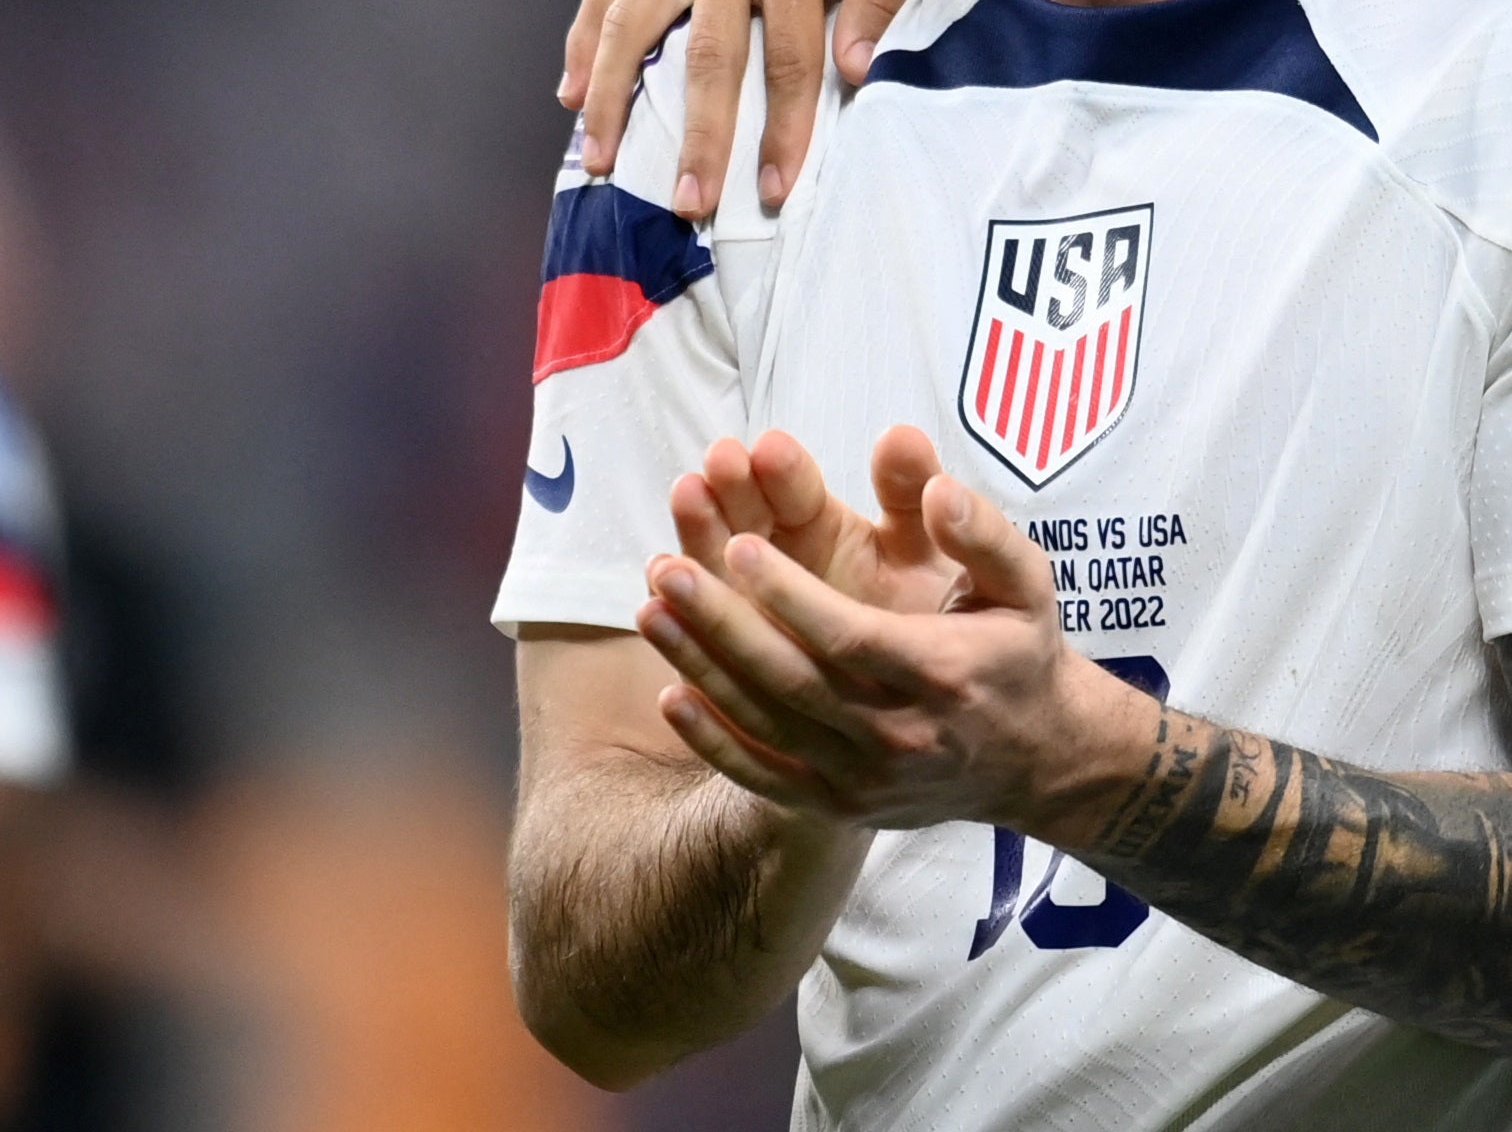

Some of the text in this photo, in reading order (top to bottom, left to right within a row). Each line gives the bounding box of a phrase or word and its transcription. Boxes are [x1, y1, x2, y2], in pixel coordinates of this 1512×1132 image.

[997, 224, 1141, 331] USA
[1027, 514, 1187, 552] ANDS VS USA
[1088, 555, 1167, 592] QATAR
[1057, 595, 1166, 632] ER 2022
